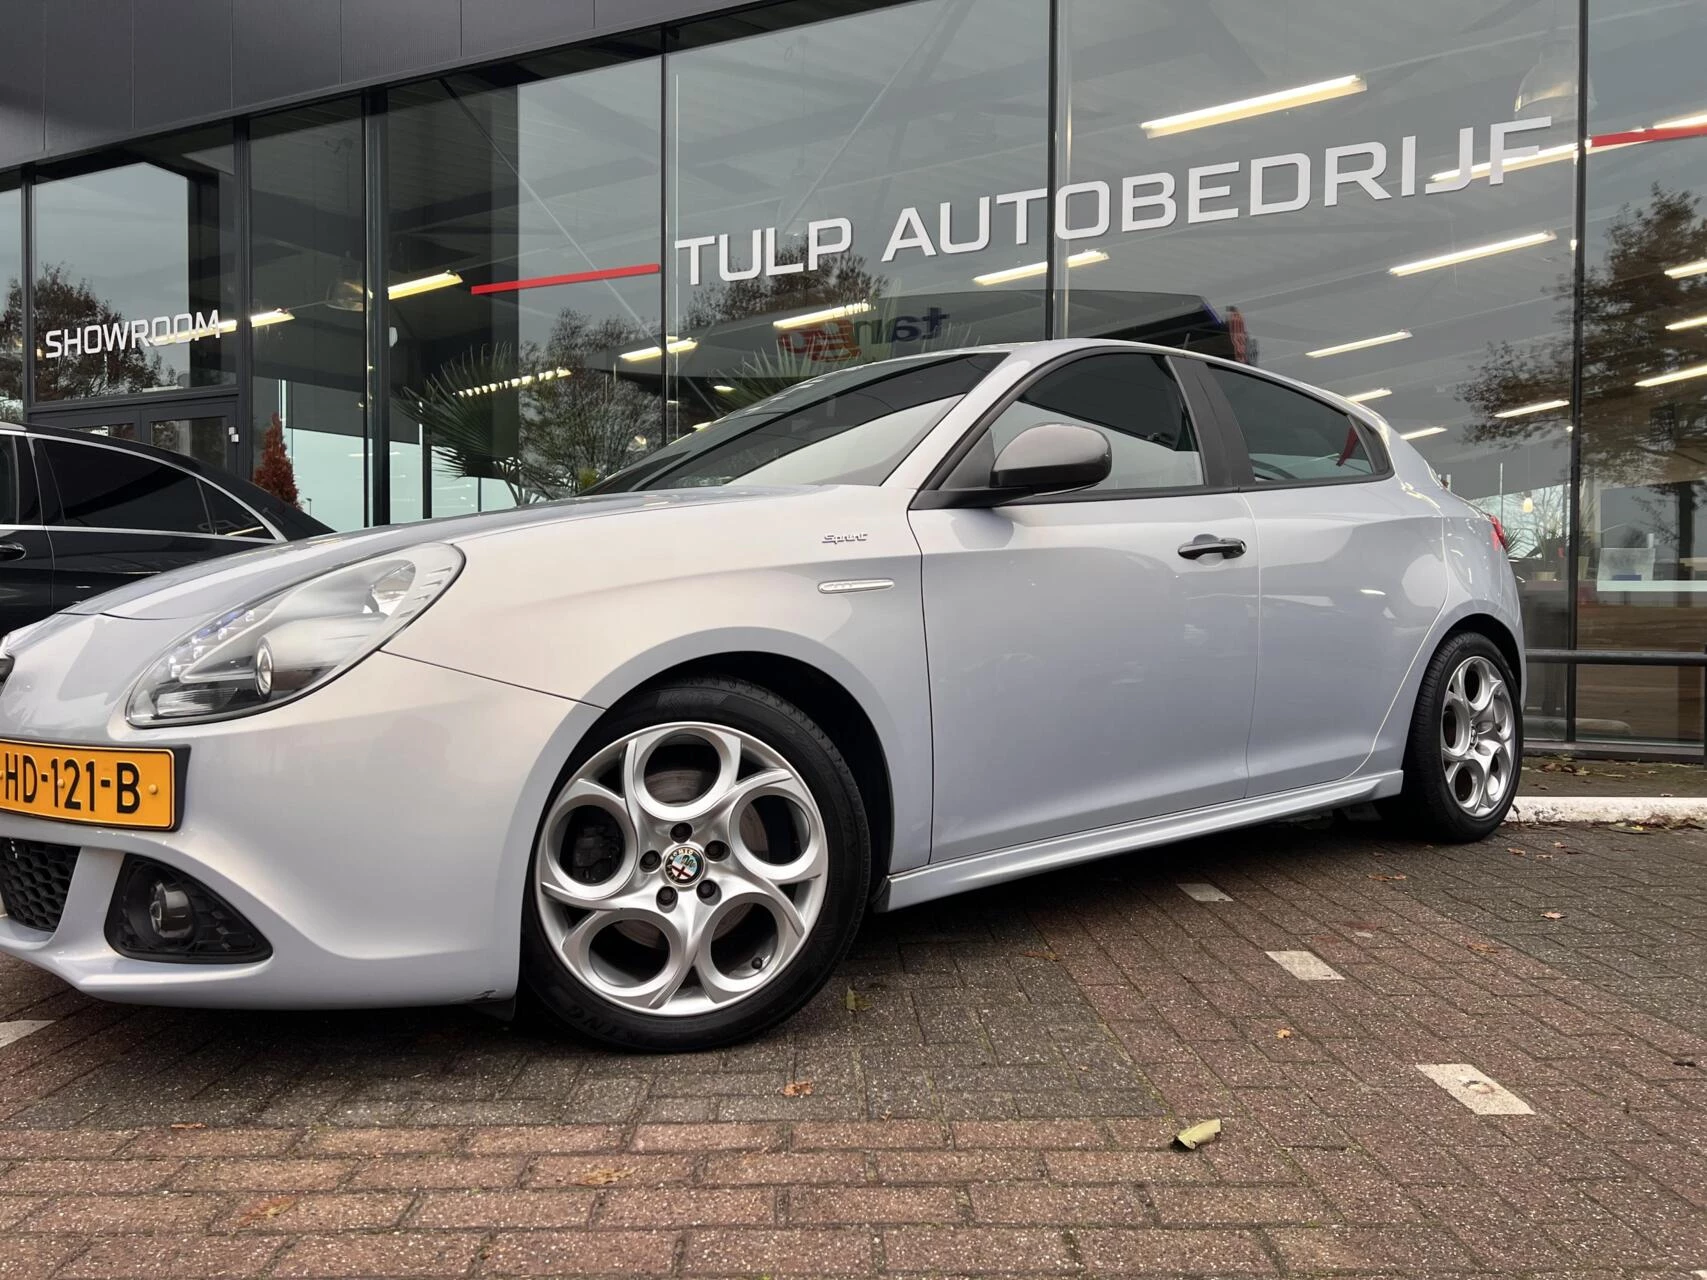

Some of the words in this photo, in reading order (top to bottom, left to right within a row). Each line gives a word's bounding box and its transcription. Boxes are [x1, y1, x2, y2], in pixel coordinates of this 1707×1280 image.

[674, 217, 852, 286] TULP
[880, 115, 1552, 262] AUTOBEDRIJF
[45, 309, 221, 359] SHOWROOM
[5, 752, 141, 815] HD-121-B
